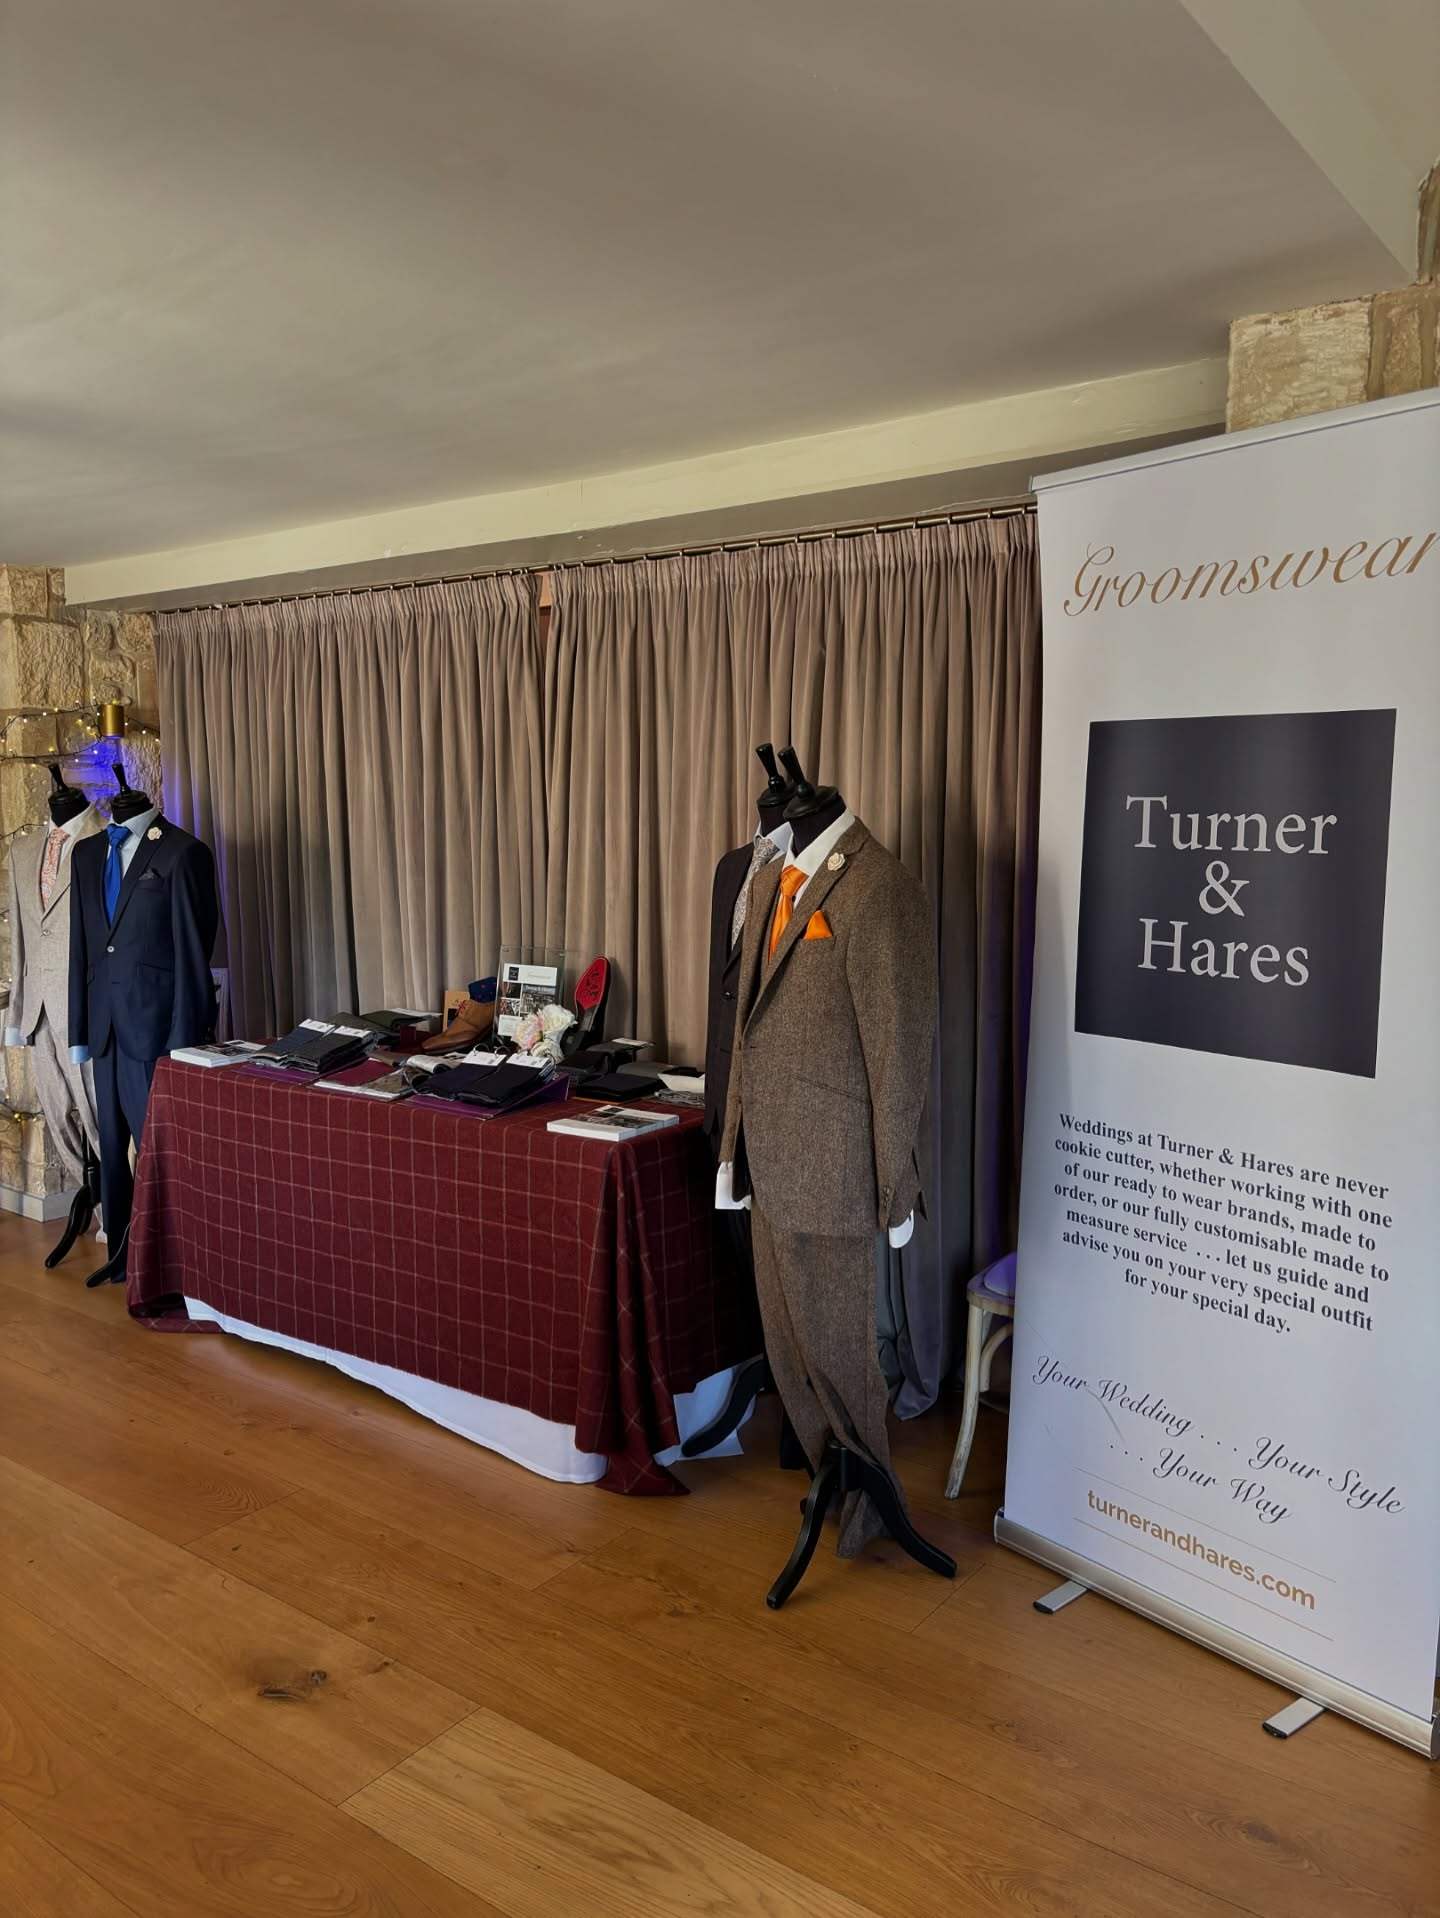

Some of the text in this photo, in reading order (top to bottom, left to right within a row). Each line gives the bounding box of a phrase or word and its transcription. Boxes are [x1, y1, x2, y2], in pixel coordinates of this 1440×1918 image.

[1063, 532, 1440, 617] Groomswear
[1126, 795, 1338, 854] Turner
[1198, 860, 1250, 917] &
[1137, 918, 1310, 986] Hares
[1055, 1138, 1393, 1228] cookie cutter, whether working with one
[1059, 1113, 1389, 1200] Weddings at Turner & Hares are never
[1054, 1182, 1389, 1282] order, or our fully customisable made to
[1064, 1162, 1376, 1251] of our ready to wear brands, made to
[1062, 1232, 1373, 1332] advise you on your very special outfit
[1066, 1209, 1130, 1236] measure
[1133, 1227, 1188, 1253] service
[1226, 1250, 1247, 1269] let
[1253, 1260, 1271, 1275] us
[1277, 1266, 1328, 1292] guide
[1334, 1279, 1369, 1303] and
[1124, 1268, 1291, 1333] for your special day.
[1032, 1355, 1088, 1391] Your
[1099, 1379, 1196, 1437] Wedding
[1247, 1436, 1324, 1480] Your
[1327, 1469, 1406, 1514] Style
[1152, 1447, 1219, 1488] Your
[1230, 1478, 1292, 1525] Way
[1087, 1489, 1316, 1611] turnerandhares.com
